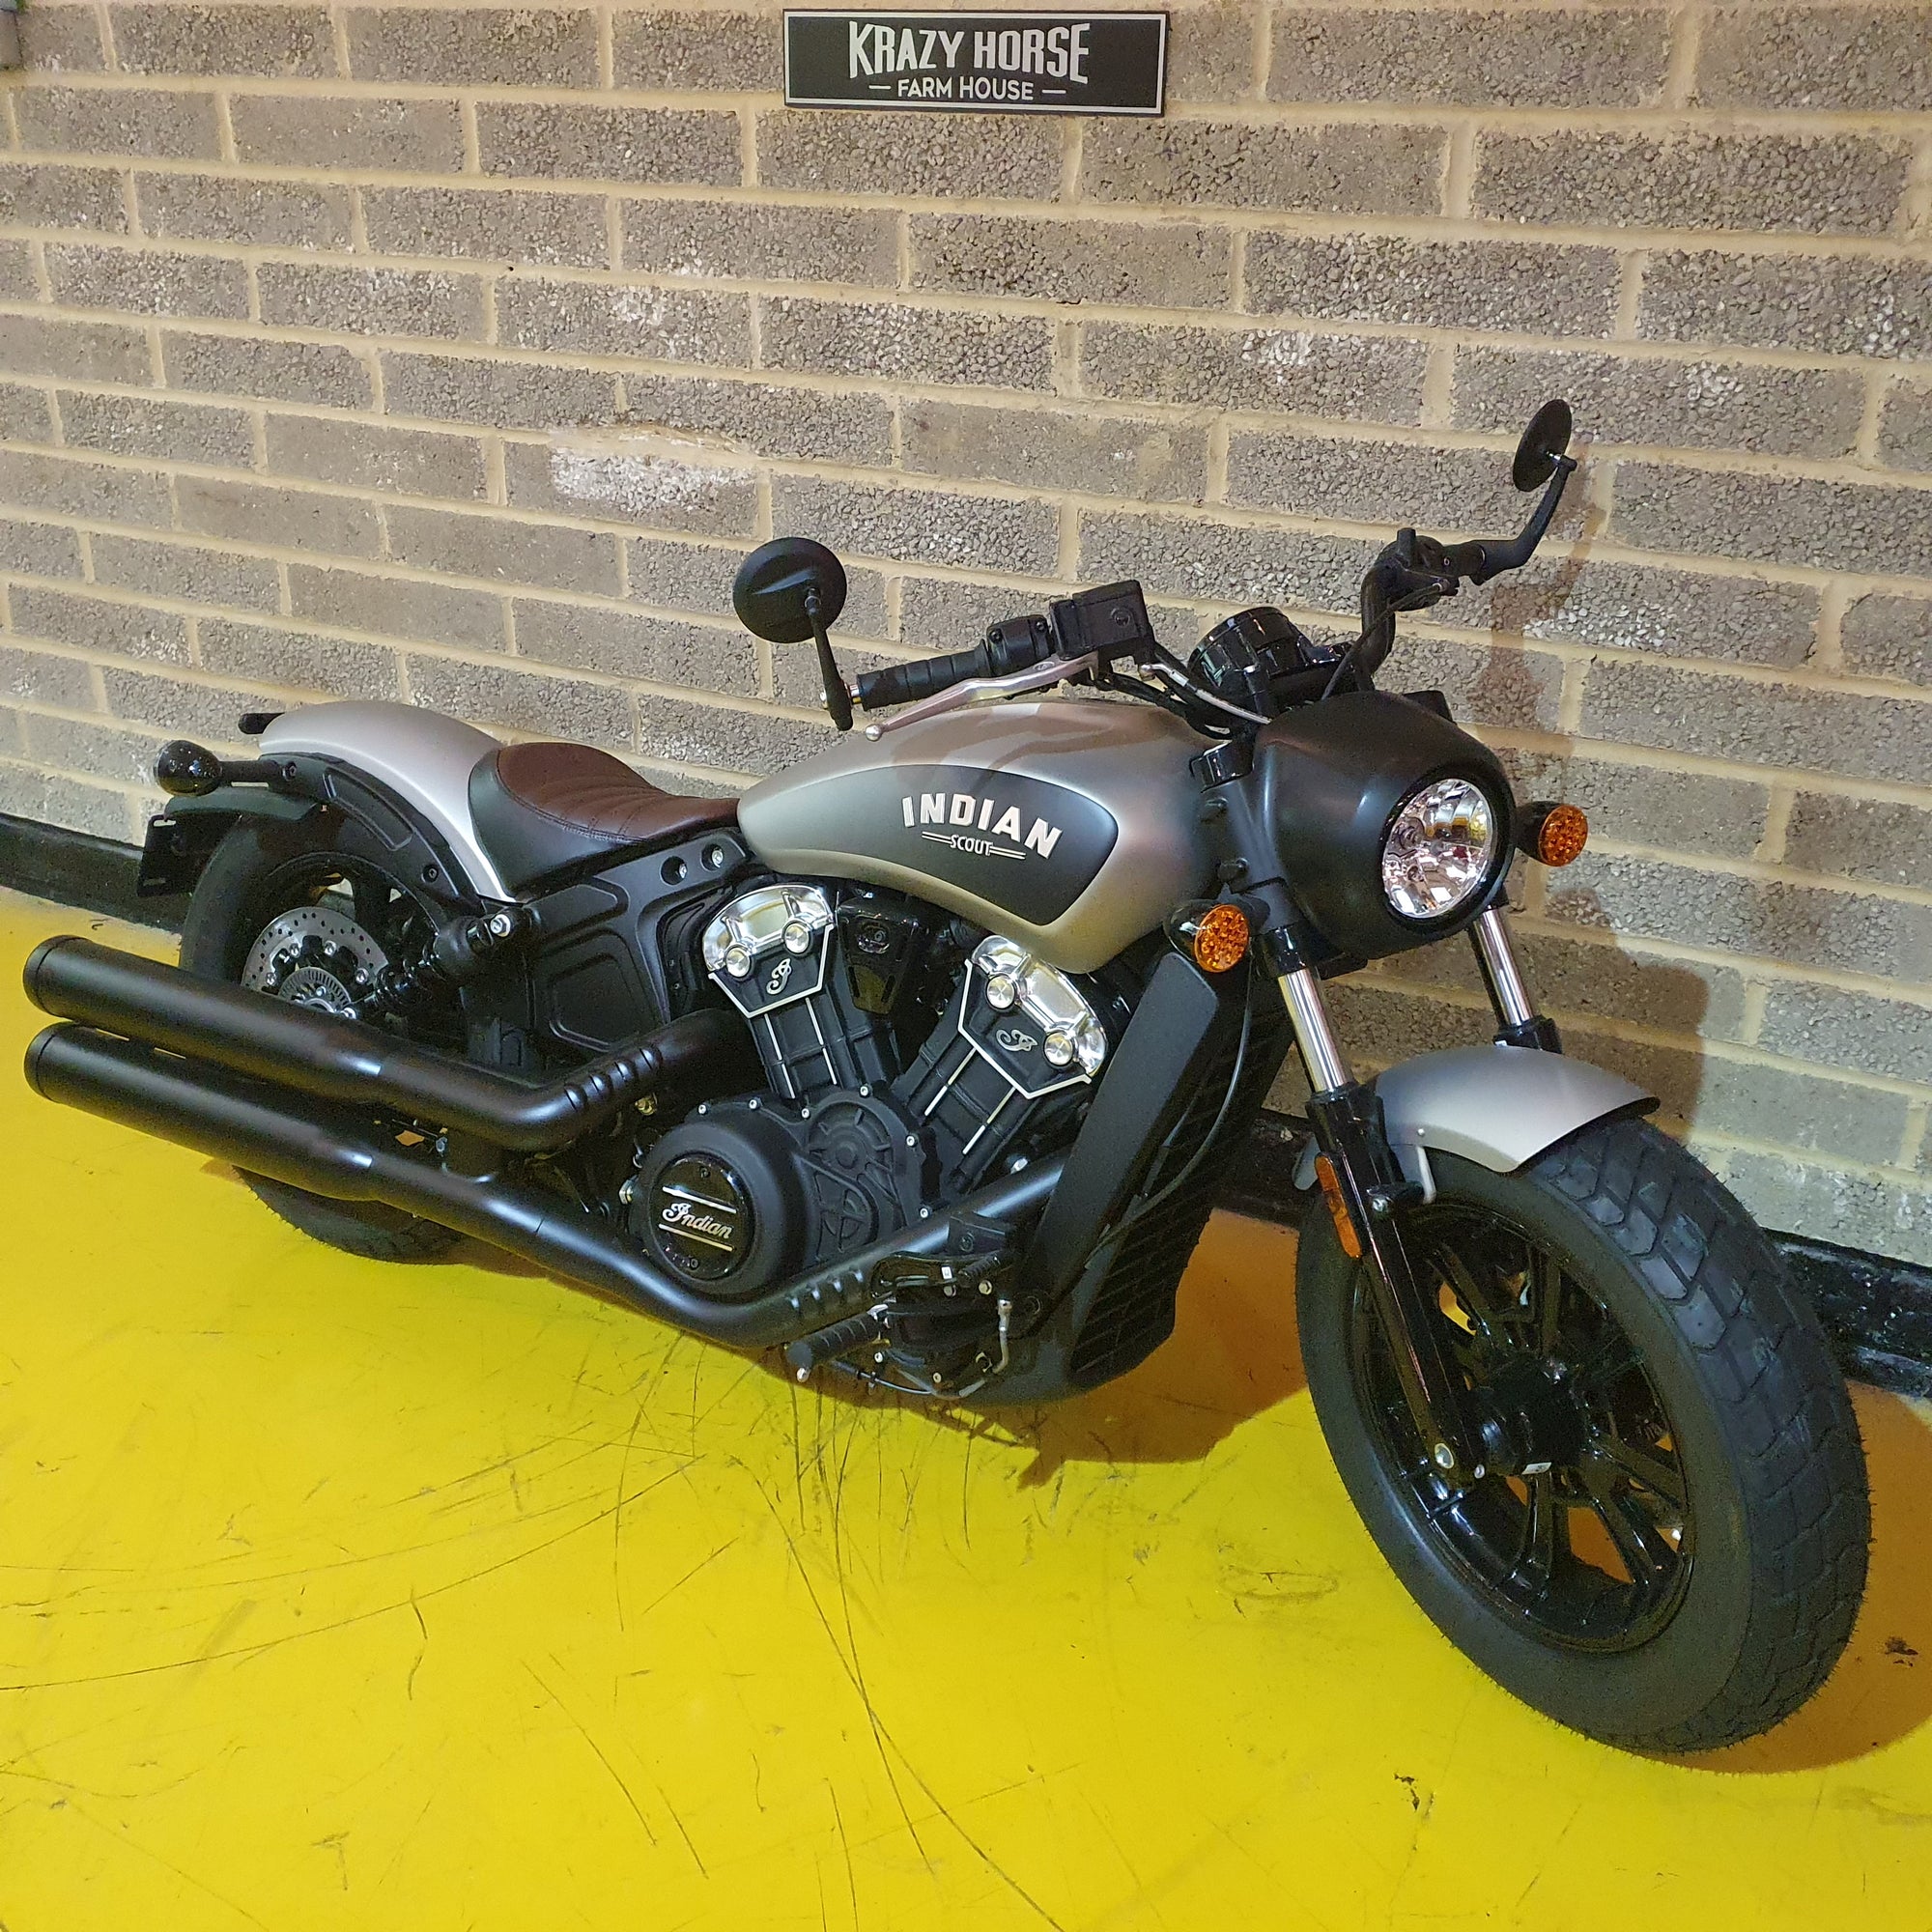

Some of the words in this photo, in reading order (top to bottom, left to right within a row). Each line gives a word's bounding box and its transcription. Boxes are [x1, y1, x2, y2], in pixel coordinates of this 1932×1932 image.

[849, 20, 964, 79] KRAZY
[974, 22, 1091, 85] HORSE
[897, 78, 952, 99] FARM
[959, 77, 1035, 100] HOUSE
[902, 792, 1062, 859] INDIAN
[950, 834, 994, 857] SCOUT
[662, 1203, 734, 1238] Indian
